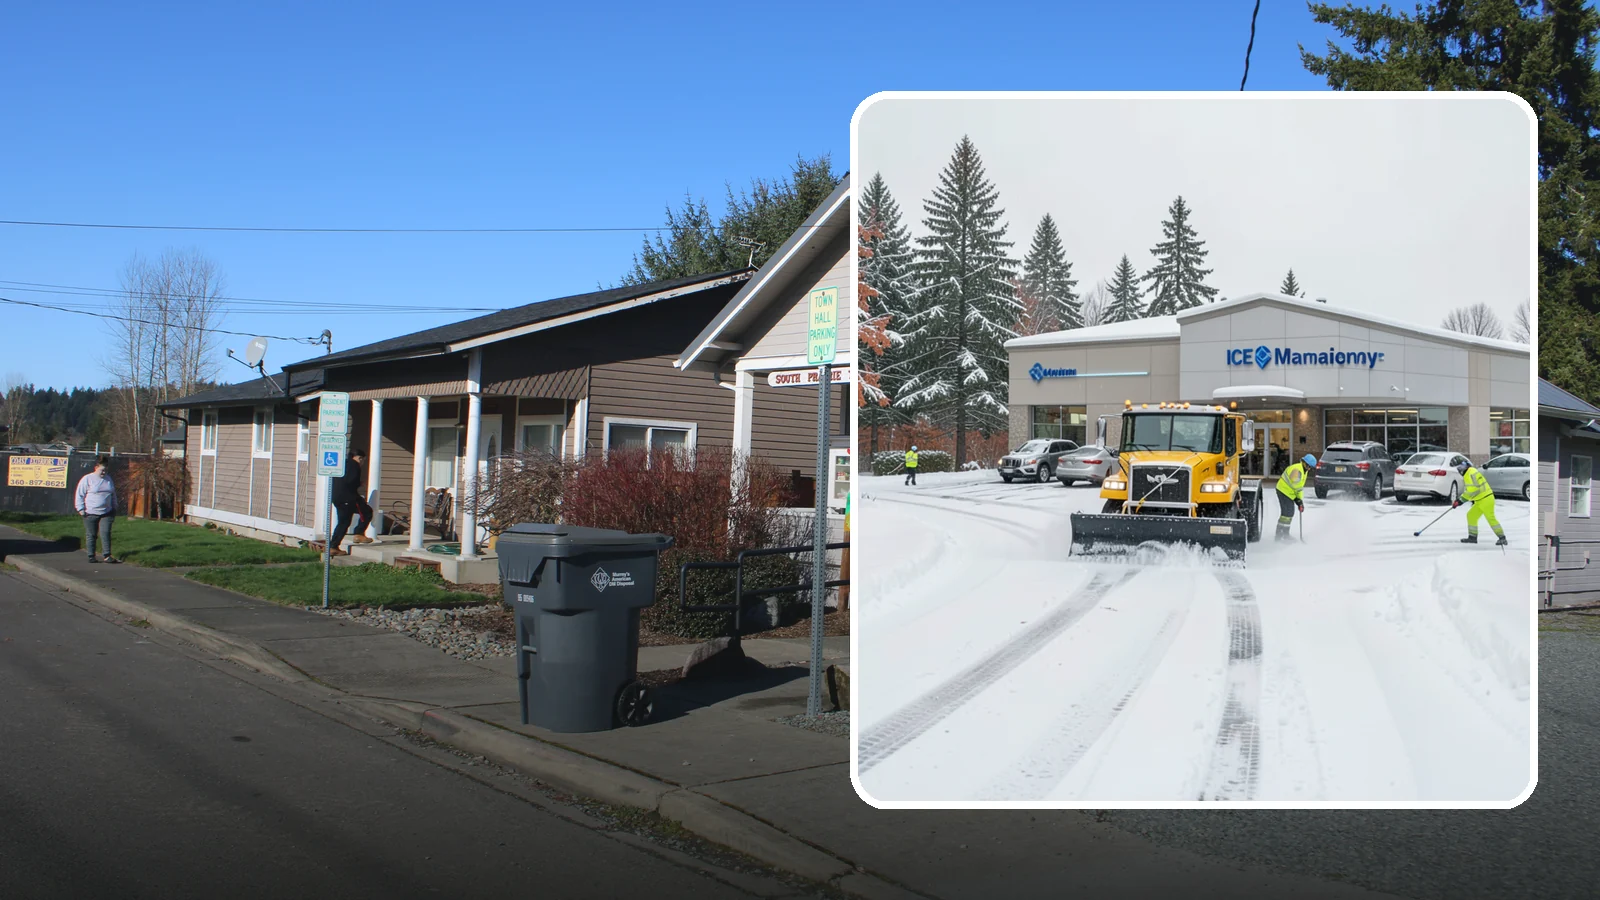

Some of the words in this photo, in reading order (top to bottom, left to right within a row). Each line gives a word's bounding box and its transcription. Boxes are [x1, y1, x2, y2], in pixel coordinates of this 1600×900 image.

[815, 295, 833, 308] TOWN
[814, 311, 831, 325] HALL
[810, 326, 836, 341] PARKING
[813, 344, 831, 358] ONLY
[1226, 348, 1254, 366] ICE
[775, 373, 802, 384] SOUTH
[322, 409, 345, 417] PARKING
[325, 420, 341, 428] ONLY
